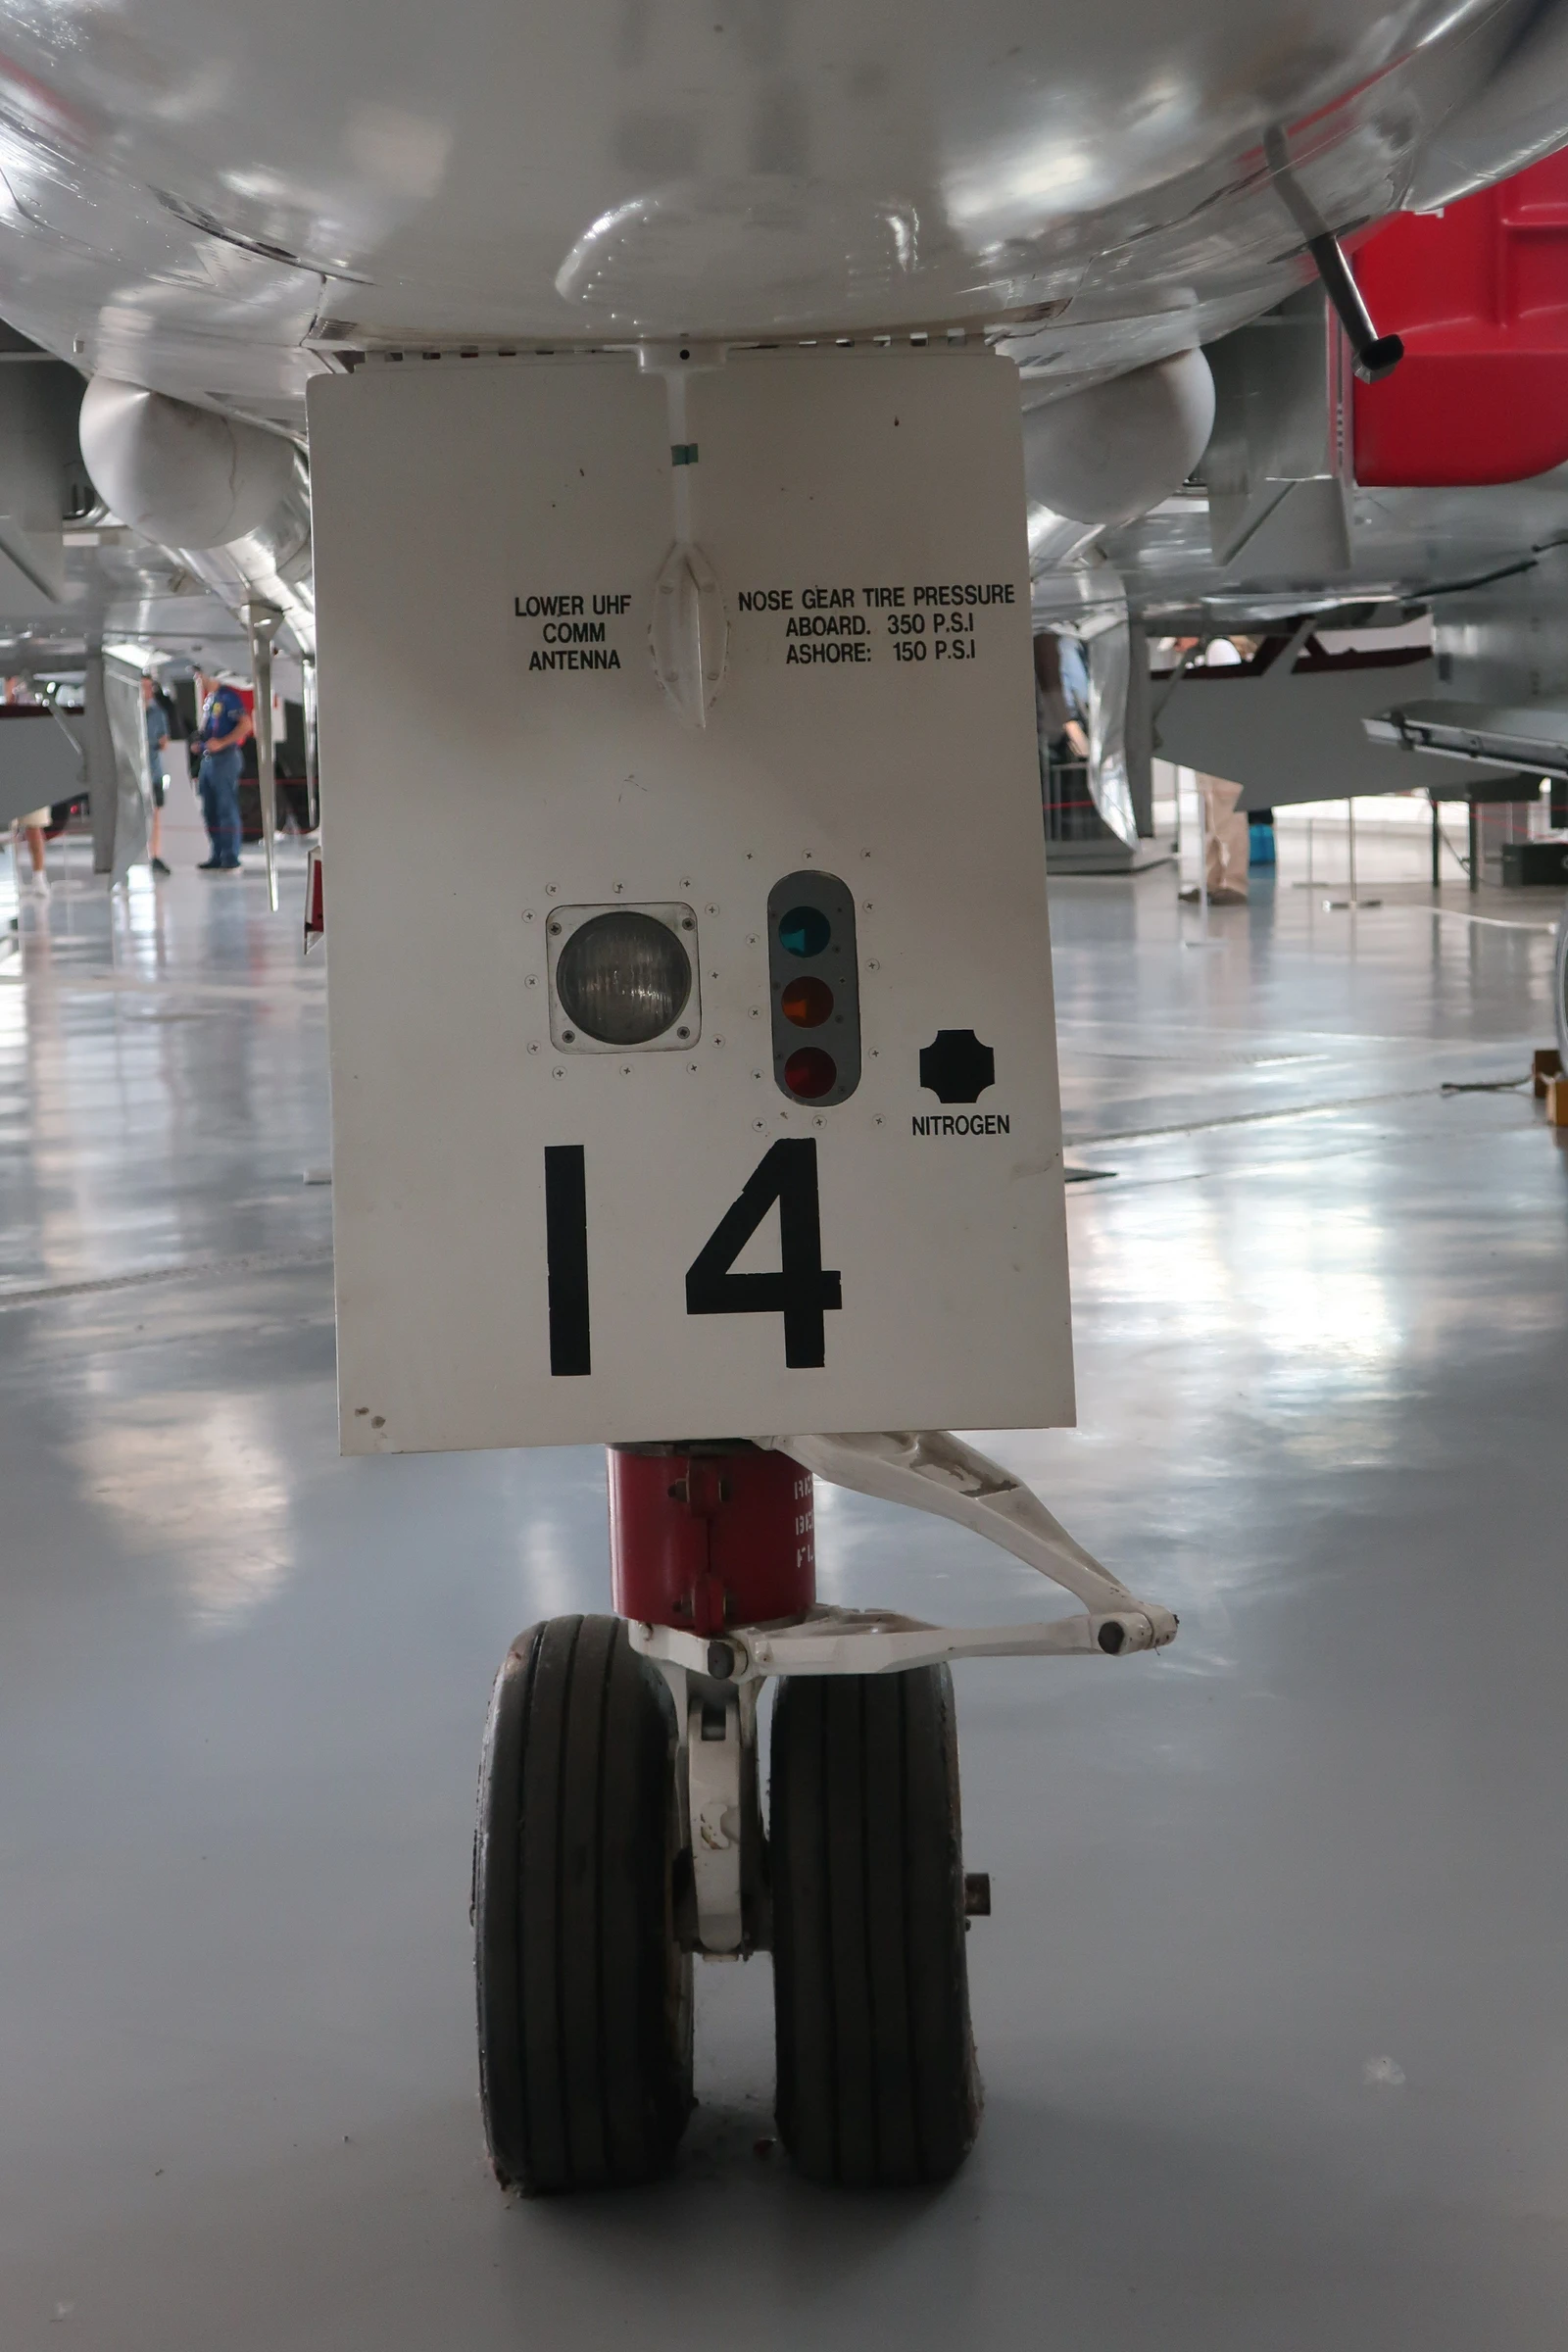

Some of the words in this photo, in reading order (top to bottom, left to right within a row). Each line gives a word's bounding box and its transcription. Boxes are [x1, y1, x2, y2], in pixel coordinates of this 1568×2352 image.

[514, 595, 584, 616] LOWER
[592, 594, 632, 615] UHF
[738, 590, 794, 612] NOSE
[802, 588, 855, 610] GEAR
[861, 587, 906, 608] TIRE
[913, 584, 1015, 607] PRESSURE
[542, 622, 606, 644] COMM
[887, 612, 925, 635] 350
[933, 612, 974, 633] P.S.I
[528, 649, 621, 671] ANTENNA
[786, 642, 871, 664] ASHORE:
[893, 640, 927, 662] 150
[935, 639, 976, 660] P.S.I
[911, 1114, 1010, 1136] NITROGEN
